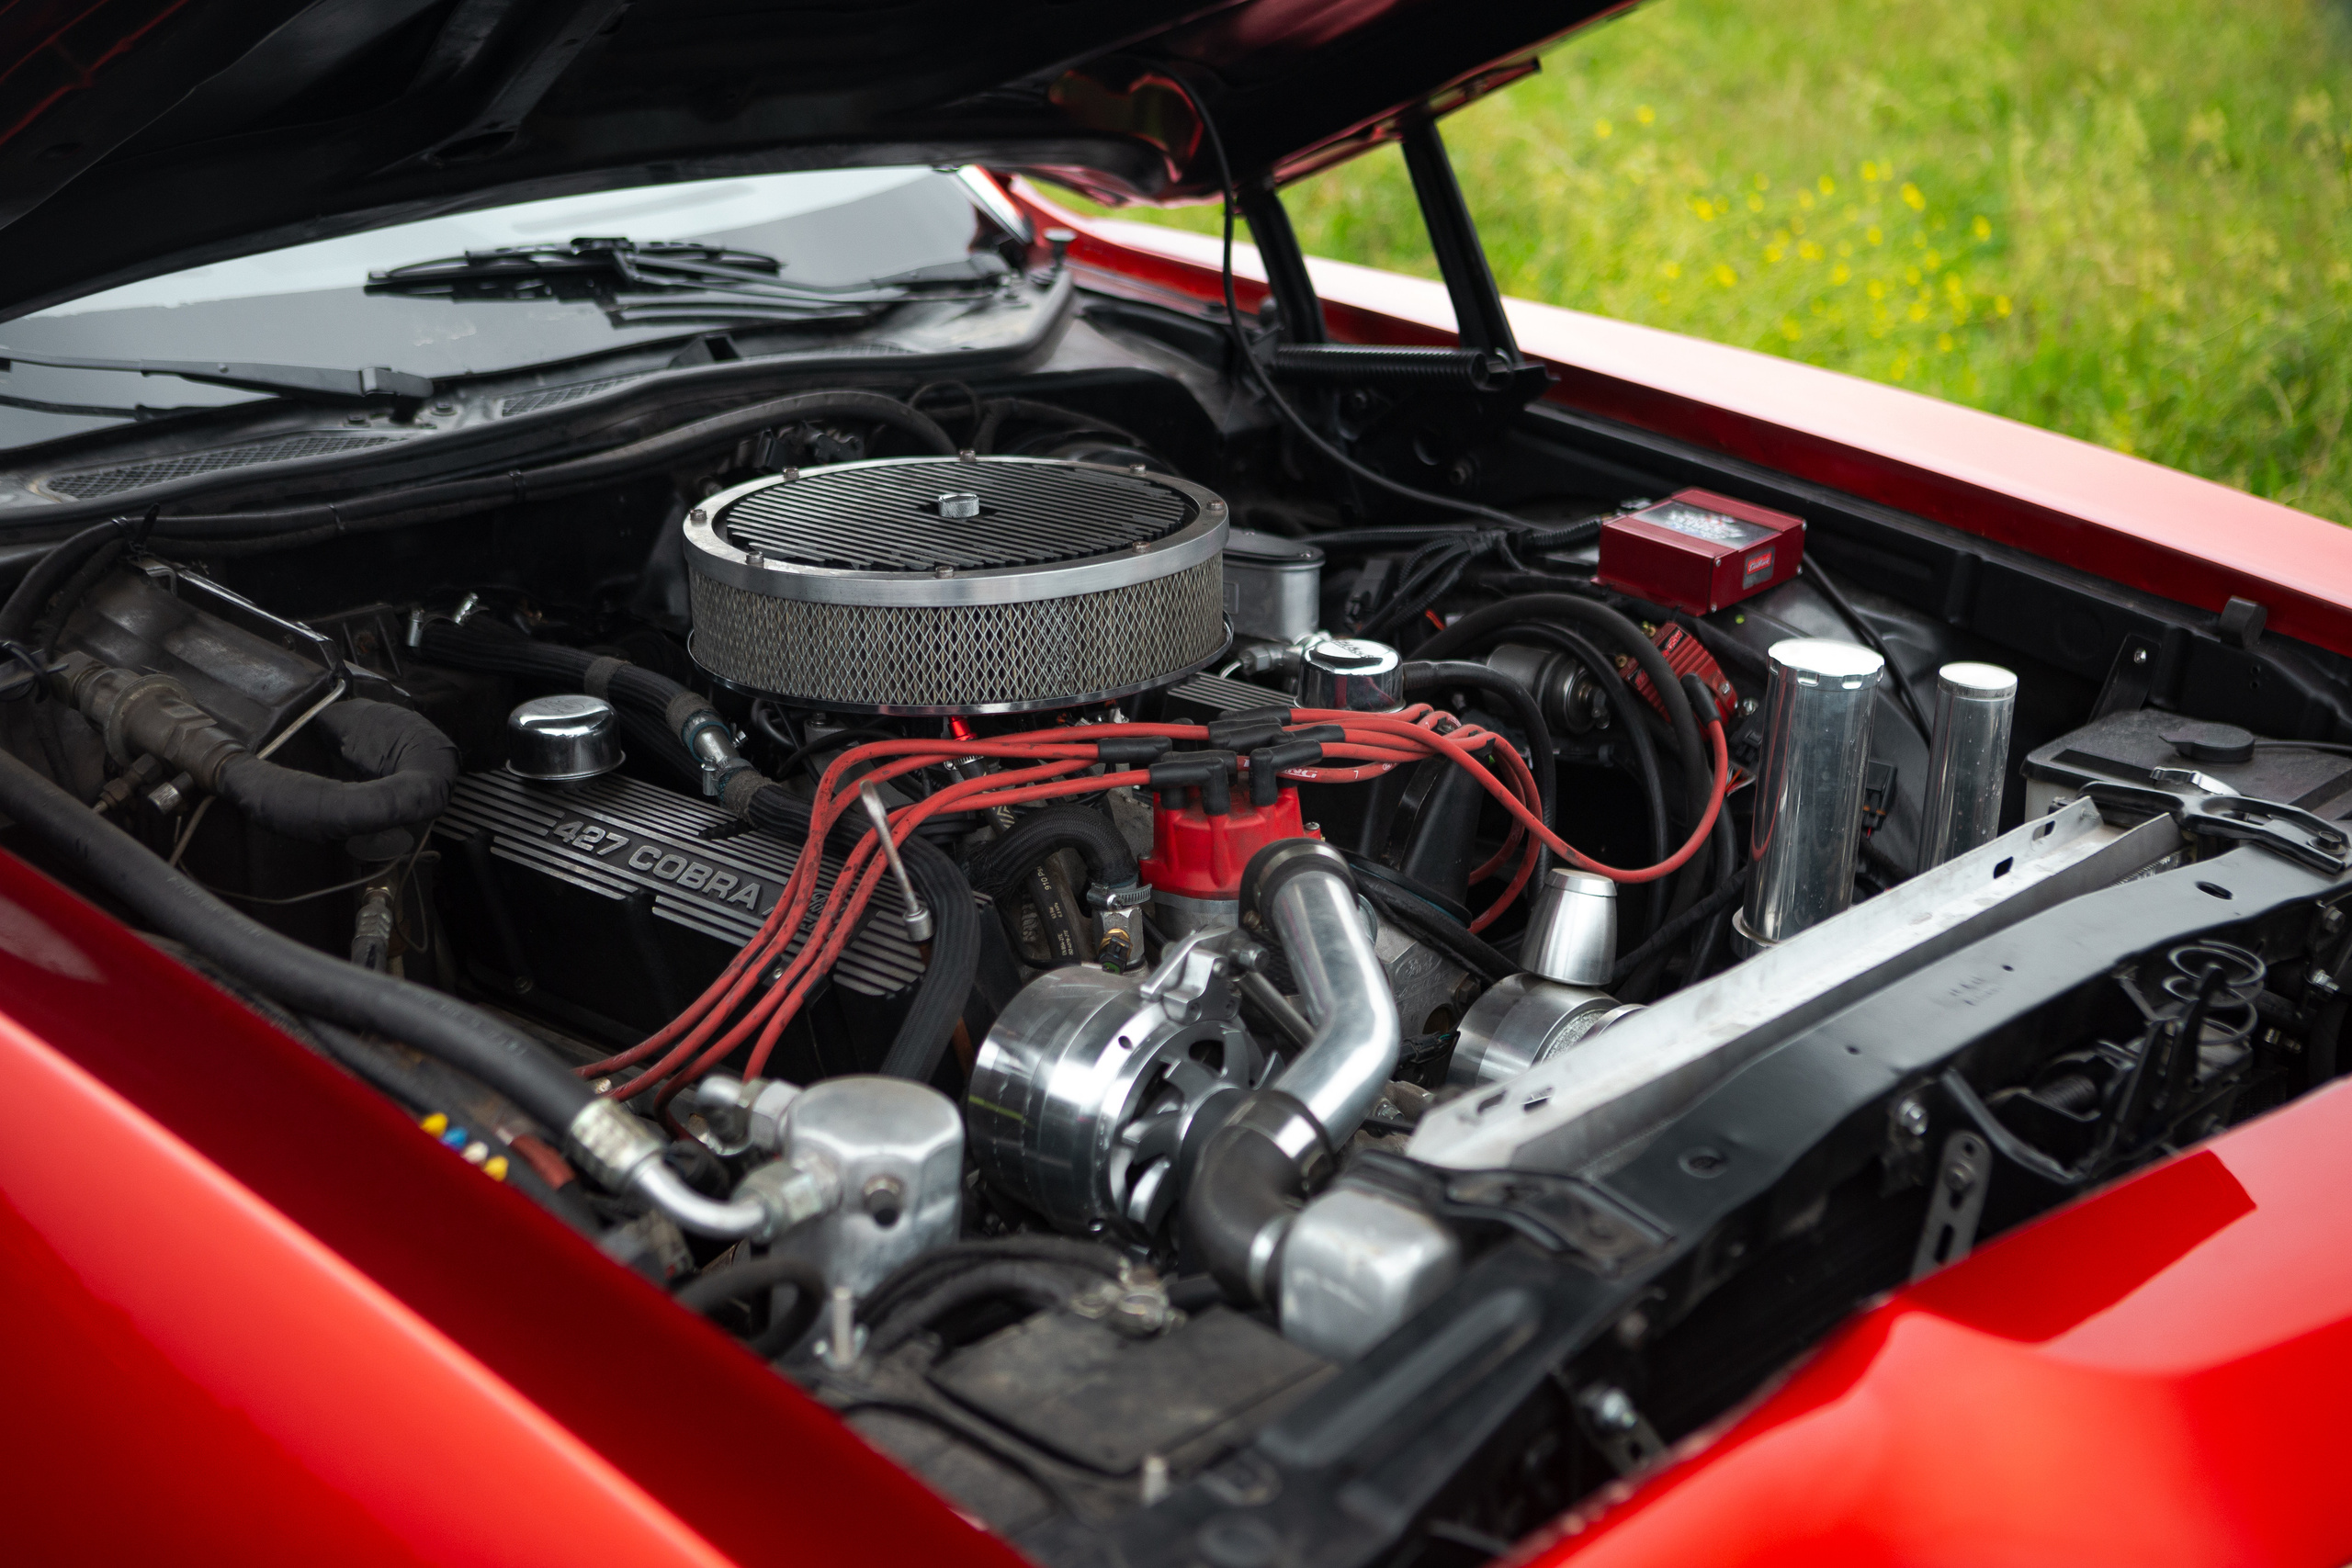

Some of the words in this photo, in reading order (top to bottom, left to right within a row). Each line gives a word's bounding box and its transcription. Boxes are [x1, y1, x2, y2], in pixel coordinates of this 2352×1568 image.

[553, 820, 629, 856] 427
[628, 845, 761, 910] COBRA
[1040, 876, 1052, 891] 910
